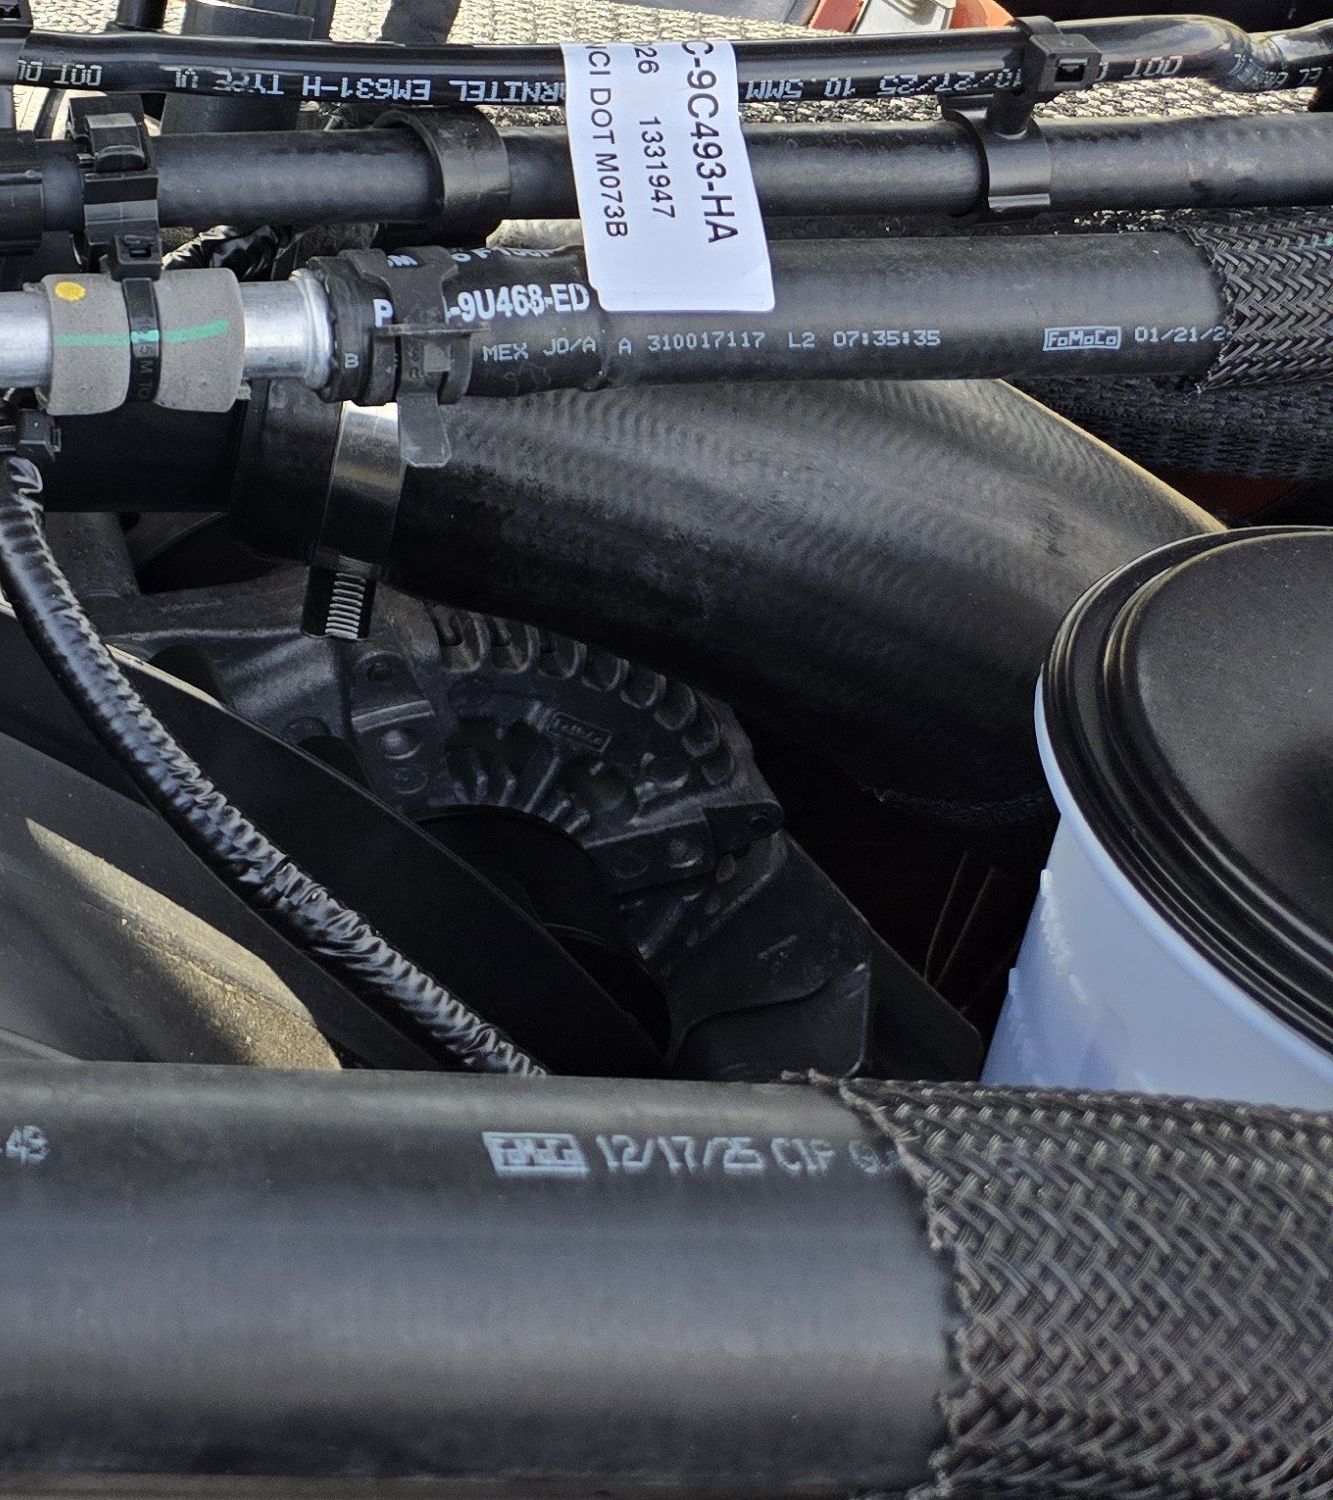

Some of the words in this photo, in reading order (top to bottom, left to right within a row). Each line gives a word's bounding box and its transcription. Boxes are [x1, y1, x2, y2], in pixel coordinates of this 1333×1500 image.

[301, 75, 431, 101] EM631-H
[589, 87, 615, 145] DOT
[639, 116, 676, 219] 1331947
[595, 152, 628, 238] M073B
[482, 342, 529, 362] MEX
[646, 330, 766, 352] 310017117
[787, 331, 816, 349] L2
[832, 329, 941, 348] 07:35:35
[1044, 326, 1121, 350] FoMoCo
